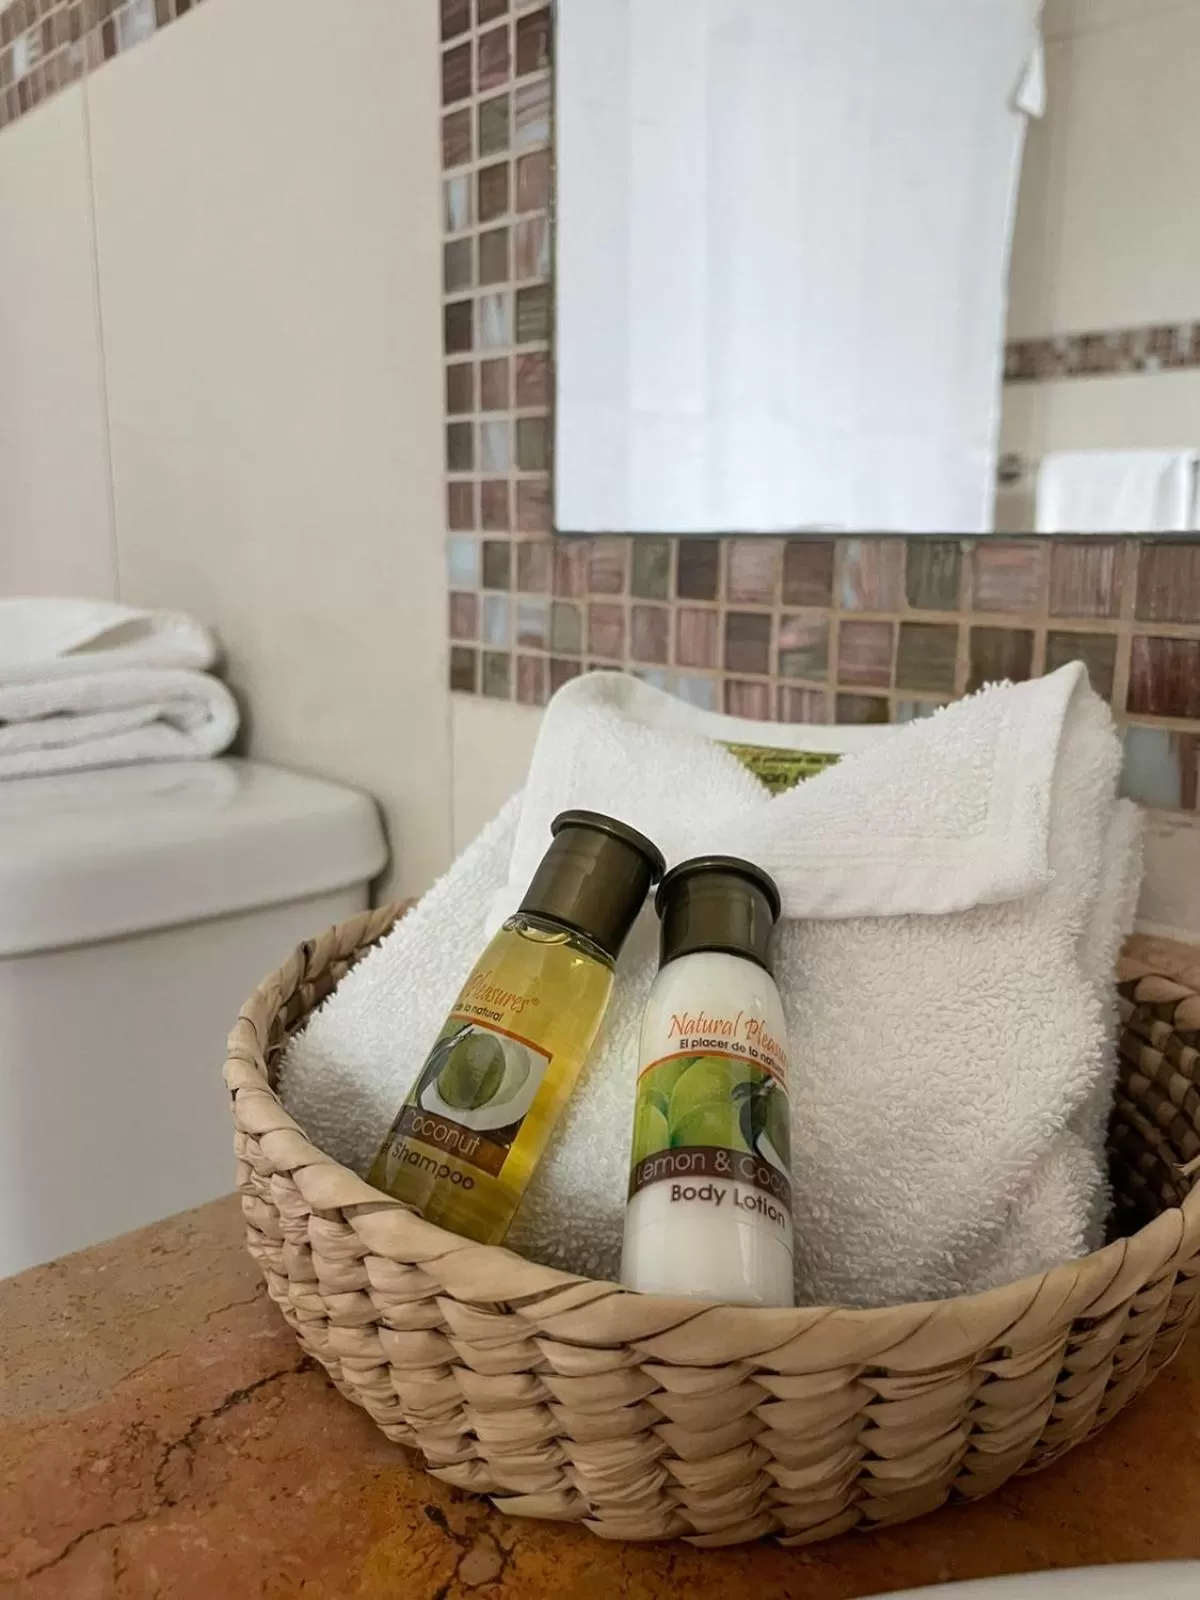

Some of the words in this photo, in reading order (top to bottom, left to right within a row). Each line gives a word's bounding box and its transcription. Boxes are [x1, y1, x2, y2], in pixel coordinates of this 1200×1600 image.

[472, 1005, 505, 1022] natural
[667, 1010, 744, 1039] Natural
[679, 1037, 689, 1050] El
[691, 1037, 729, 1050] placer
[731, 1042, 747, 1054] de
[749, 1046, 759, 1058] la
[391, 1141, 475, 1190] Shampoo
[636, 1152, 707, 1186] Lemon
[714, 1150, 733, 1173] &
[670, 1183, 727, 1208] Body
[733, 1187, 787, 1230] Lotion
